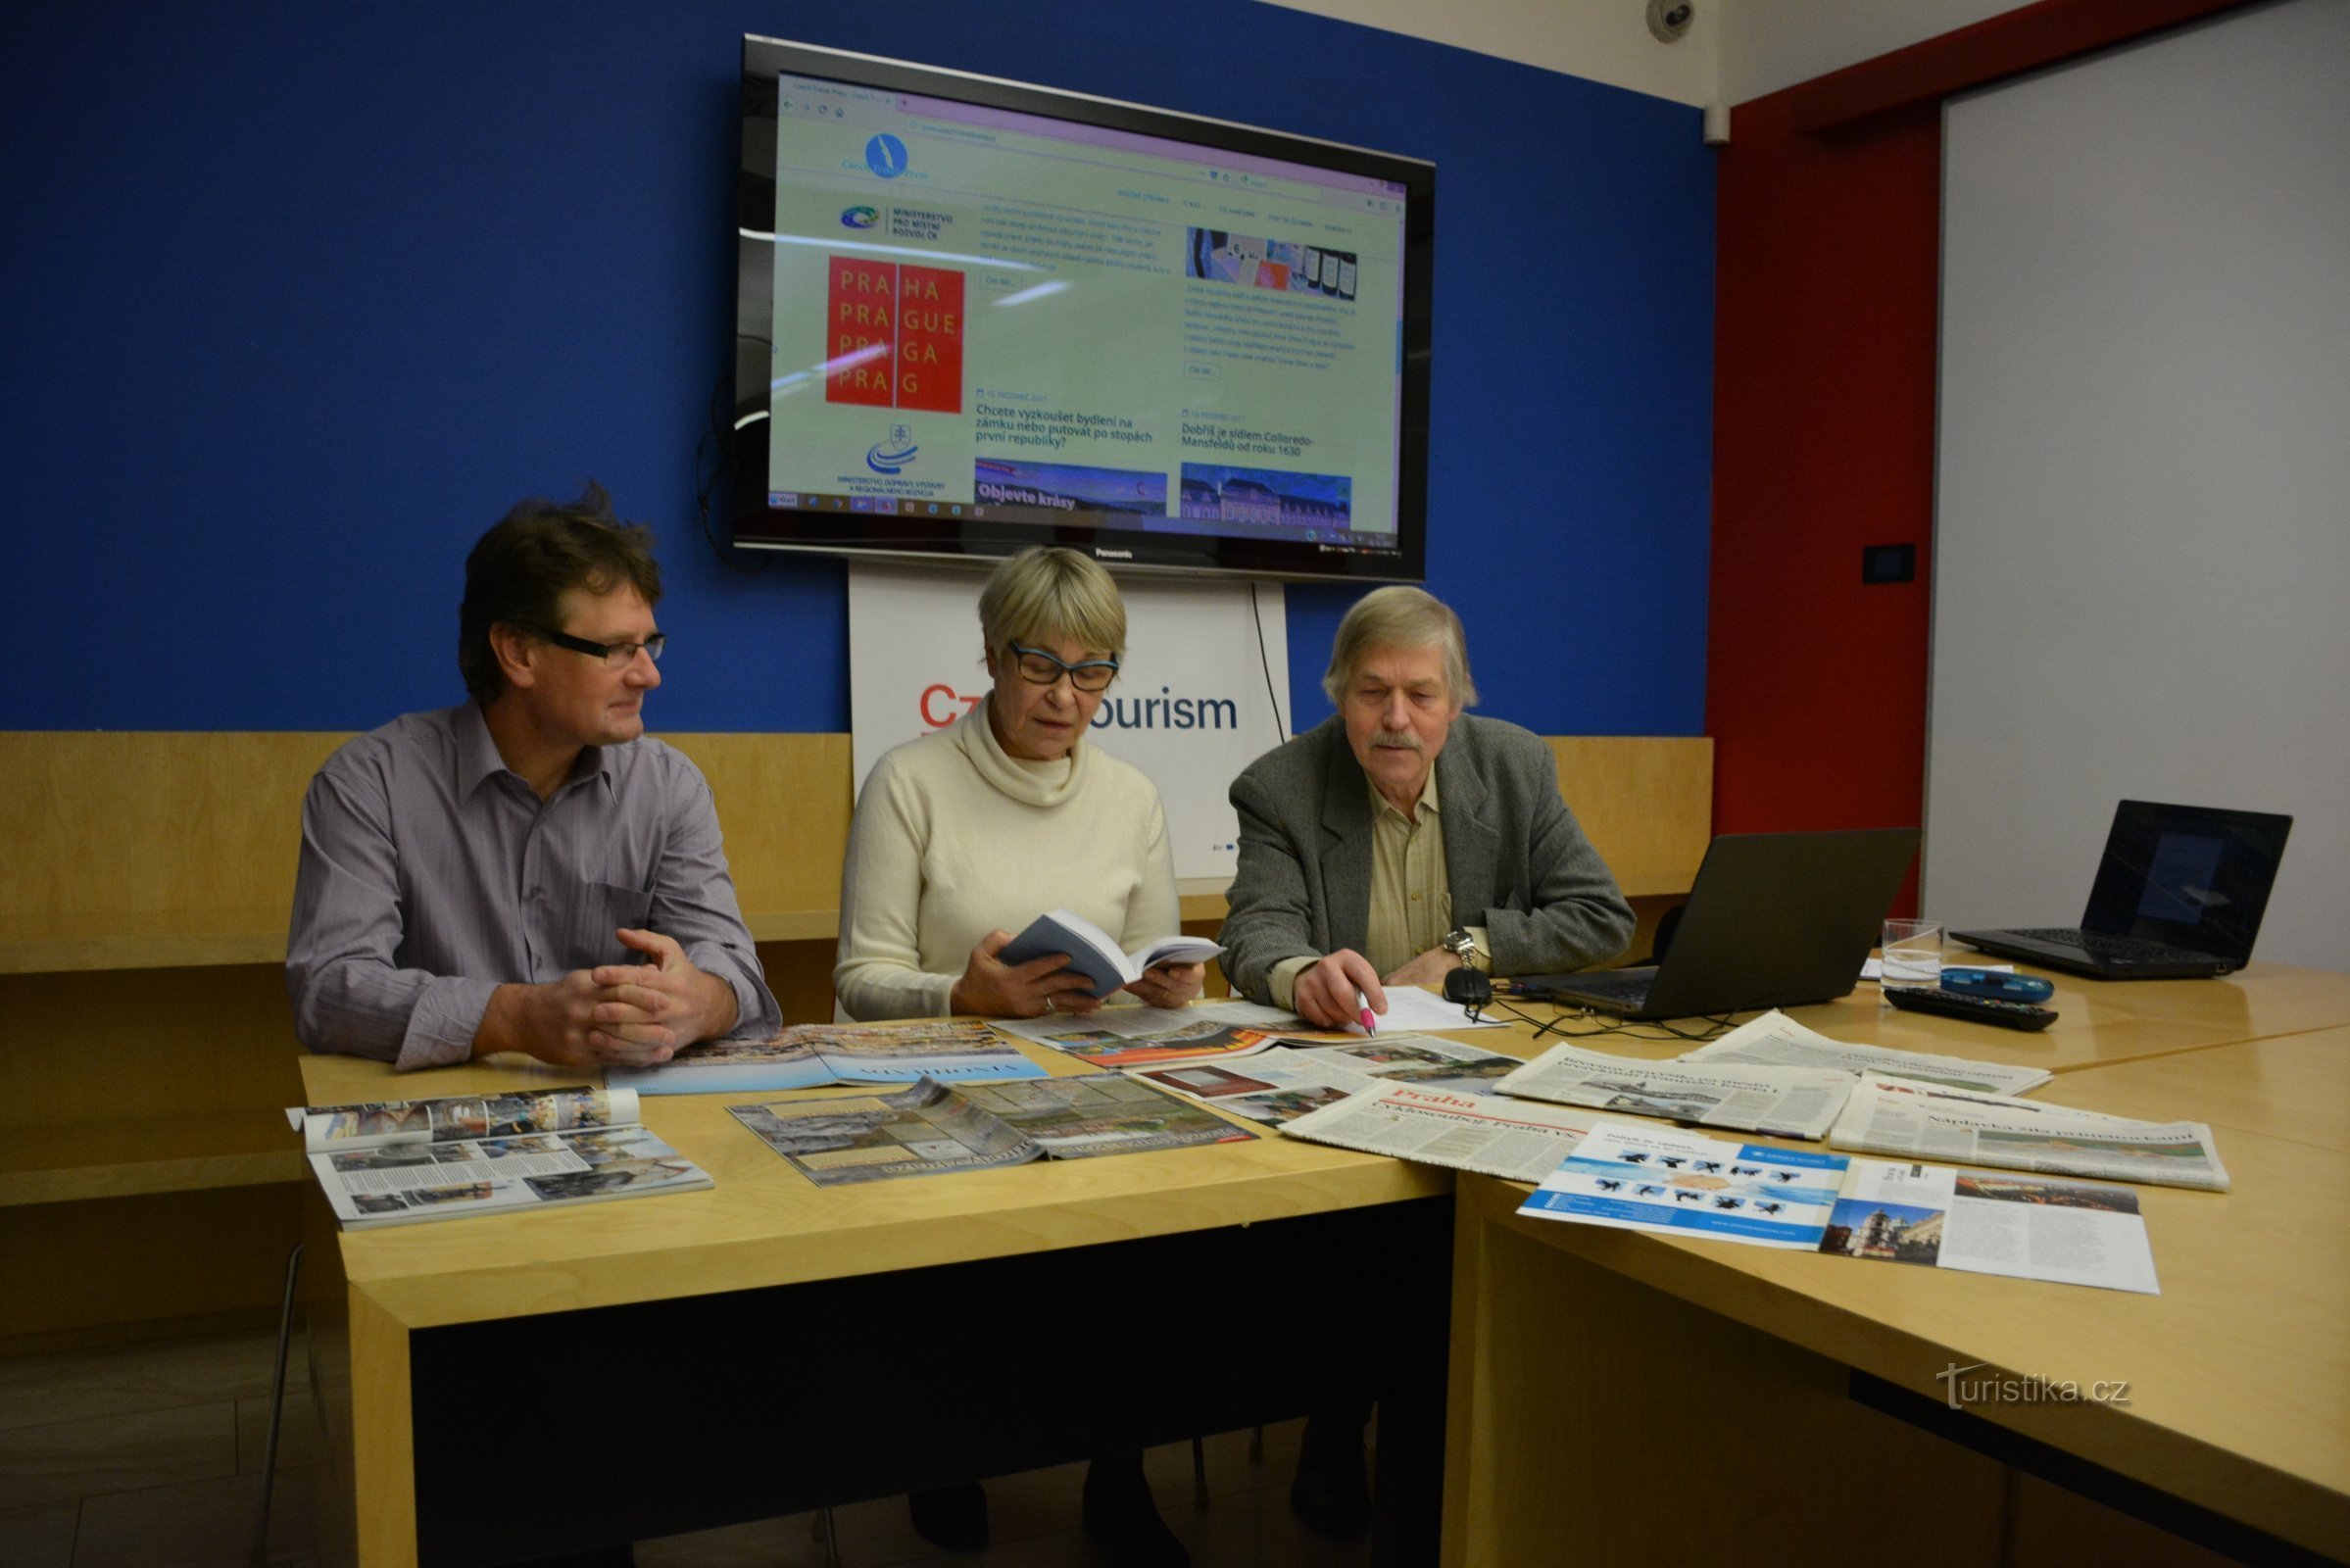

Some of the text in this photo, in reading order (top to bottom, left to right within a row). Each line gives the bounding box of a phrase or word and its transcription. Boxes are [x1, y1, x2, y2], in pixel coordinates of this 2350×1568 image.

[893, 208, 954, 224] MINISTERSTVO
[893, 218, 911, 228] PRO
[893, 227, 926, 239] ROZVOJ
[976, 404, 1133, 428] Chcete vyzkoušet bydlení na
[976, 418, 1153, 444] zámku nebo putovat po stopách
[1182, 423, 1215, 436] Dobříš
[1217, 427, 1227, 440] je
[1229, 428, 1262, 441] sídlem
[976, 431, 1066, 450] první republiky?
[1237, 442, 1250, 452] od
[1252, 444, 1276, 455] roku
[1278, 445, 1301, 457] 1630
[837, 475, 883, 485] MINISTERSTVO
[978, 483, 1075, 512] Objevte krásy
[1096, 548, 1133, 560] Panasonic
[1392, 1088, 1477, 1109] Praha
